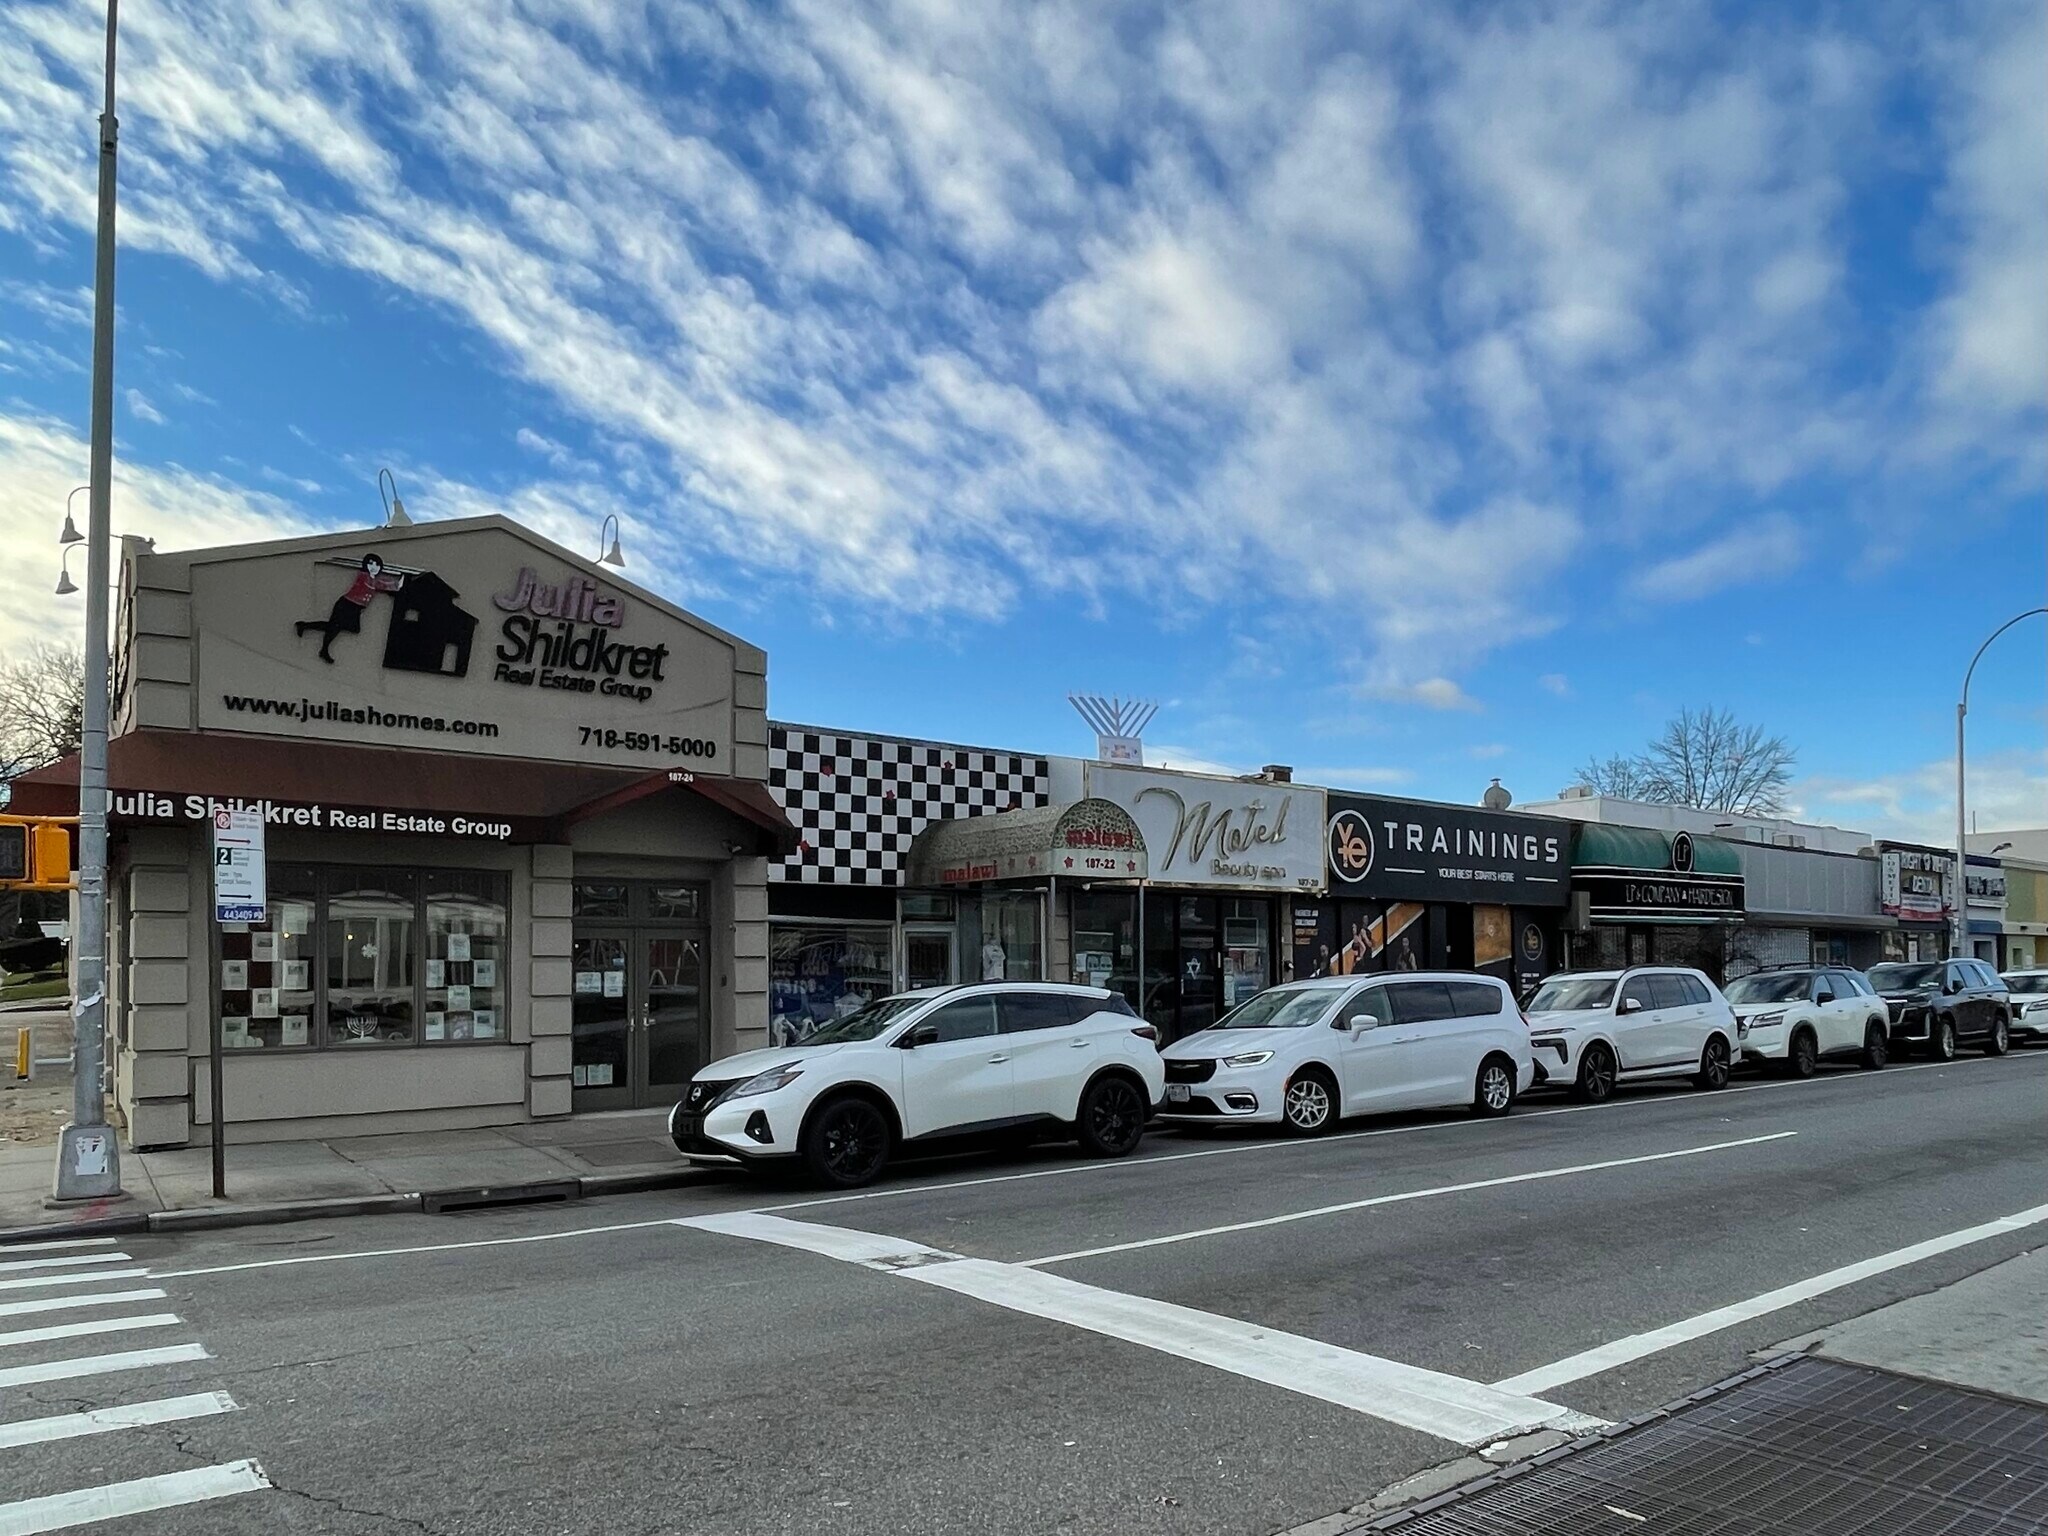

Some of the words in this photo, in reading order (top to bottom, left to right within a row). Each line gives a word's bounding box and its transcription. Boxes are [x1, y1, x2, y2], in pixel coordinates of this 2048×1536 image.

[492, 567, 626, 629] Julia
[496, 615, 670, 682] Shildkret
[494, 663, 536, 686] Real
[539, 669, 596, 694] Estate
[600, 678, 653, 703] Group
[223, 694, 499, 738] www.juliashomes.com
[578, 726, 716, 758] 718-591-5000
[329, 810, 375, 829] Real
[382, 813, 445, 834] Estate
[451, 817, 511, 840] Group
[220, 848, 229, 864] 2
[1384, 821, 1558, 863] TRAININGS
[943, 860, 999, 882] malawi
[1211, 858, 1259, 880] Beauty
[1438, 868, 1456, 878] YOUR
[1457, 869, 1473, 880] BEST
